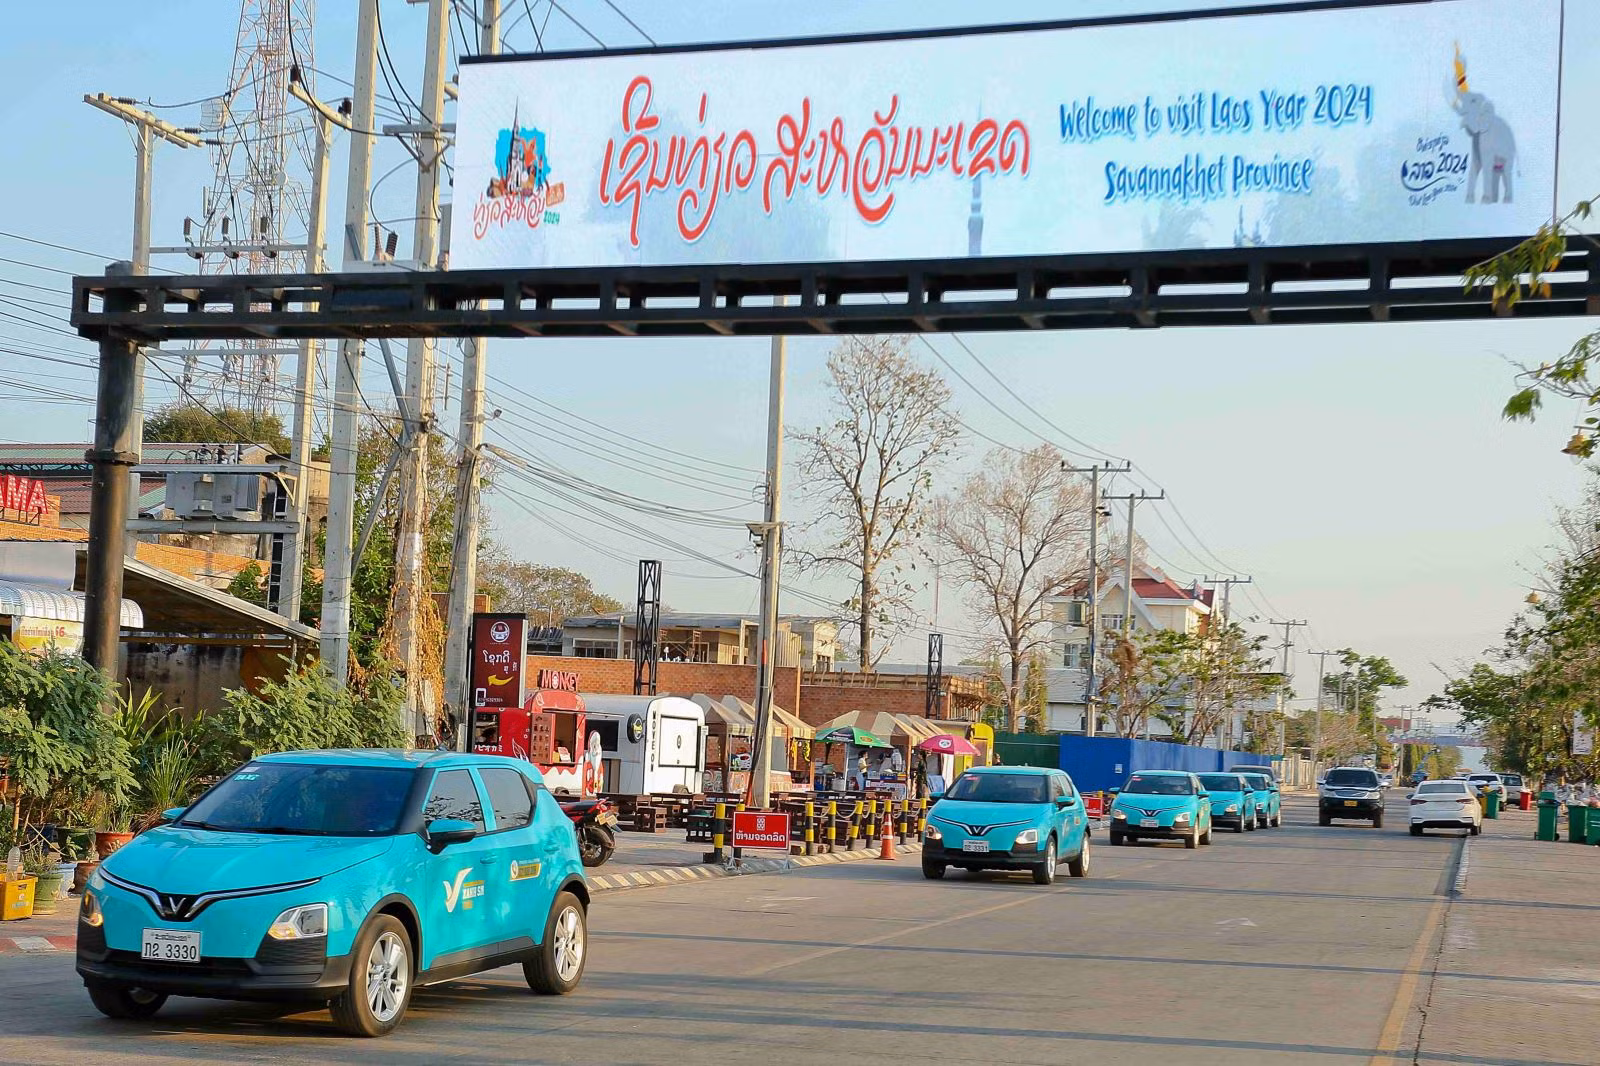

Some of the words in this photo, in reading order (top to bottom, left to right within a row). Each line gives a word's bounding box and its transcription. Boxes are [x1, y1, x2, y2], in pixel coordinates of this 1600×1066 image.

[1060, 96, 1136, 138] Welcome
[1145, 95, 1160, 130] to
[1167, 93, 1205, 132] visit
[1211, 93, 1252, 129] Laos
[1260, 89, 1305, 128] Year
[1314, 84, 1373, 123] 2024
[1436, 152, 1469, 174] 2024
[1104, 154, 1225, 200] Savannakhet
[1231, 154, 1312, 191] Province
[543, 211, 560, 225] 2024
[0, 473, 48, 514] MA
[541, 669, 580, 690] MONKEY
[165, 943, 197, 960] 3330
